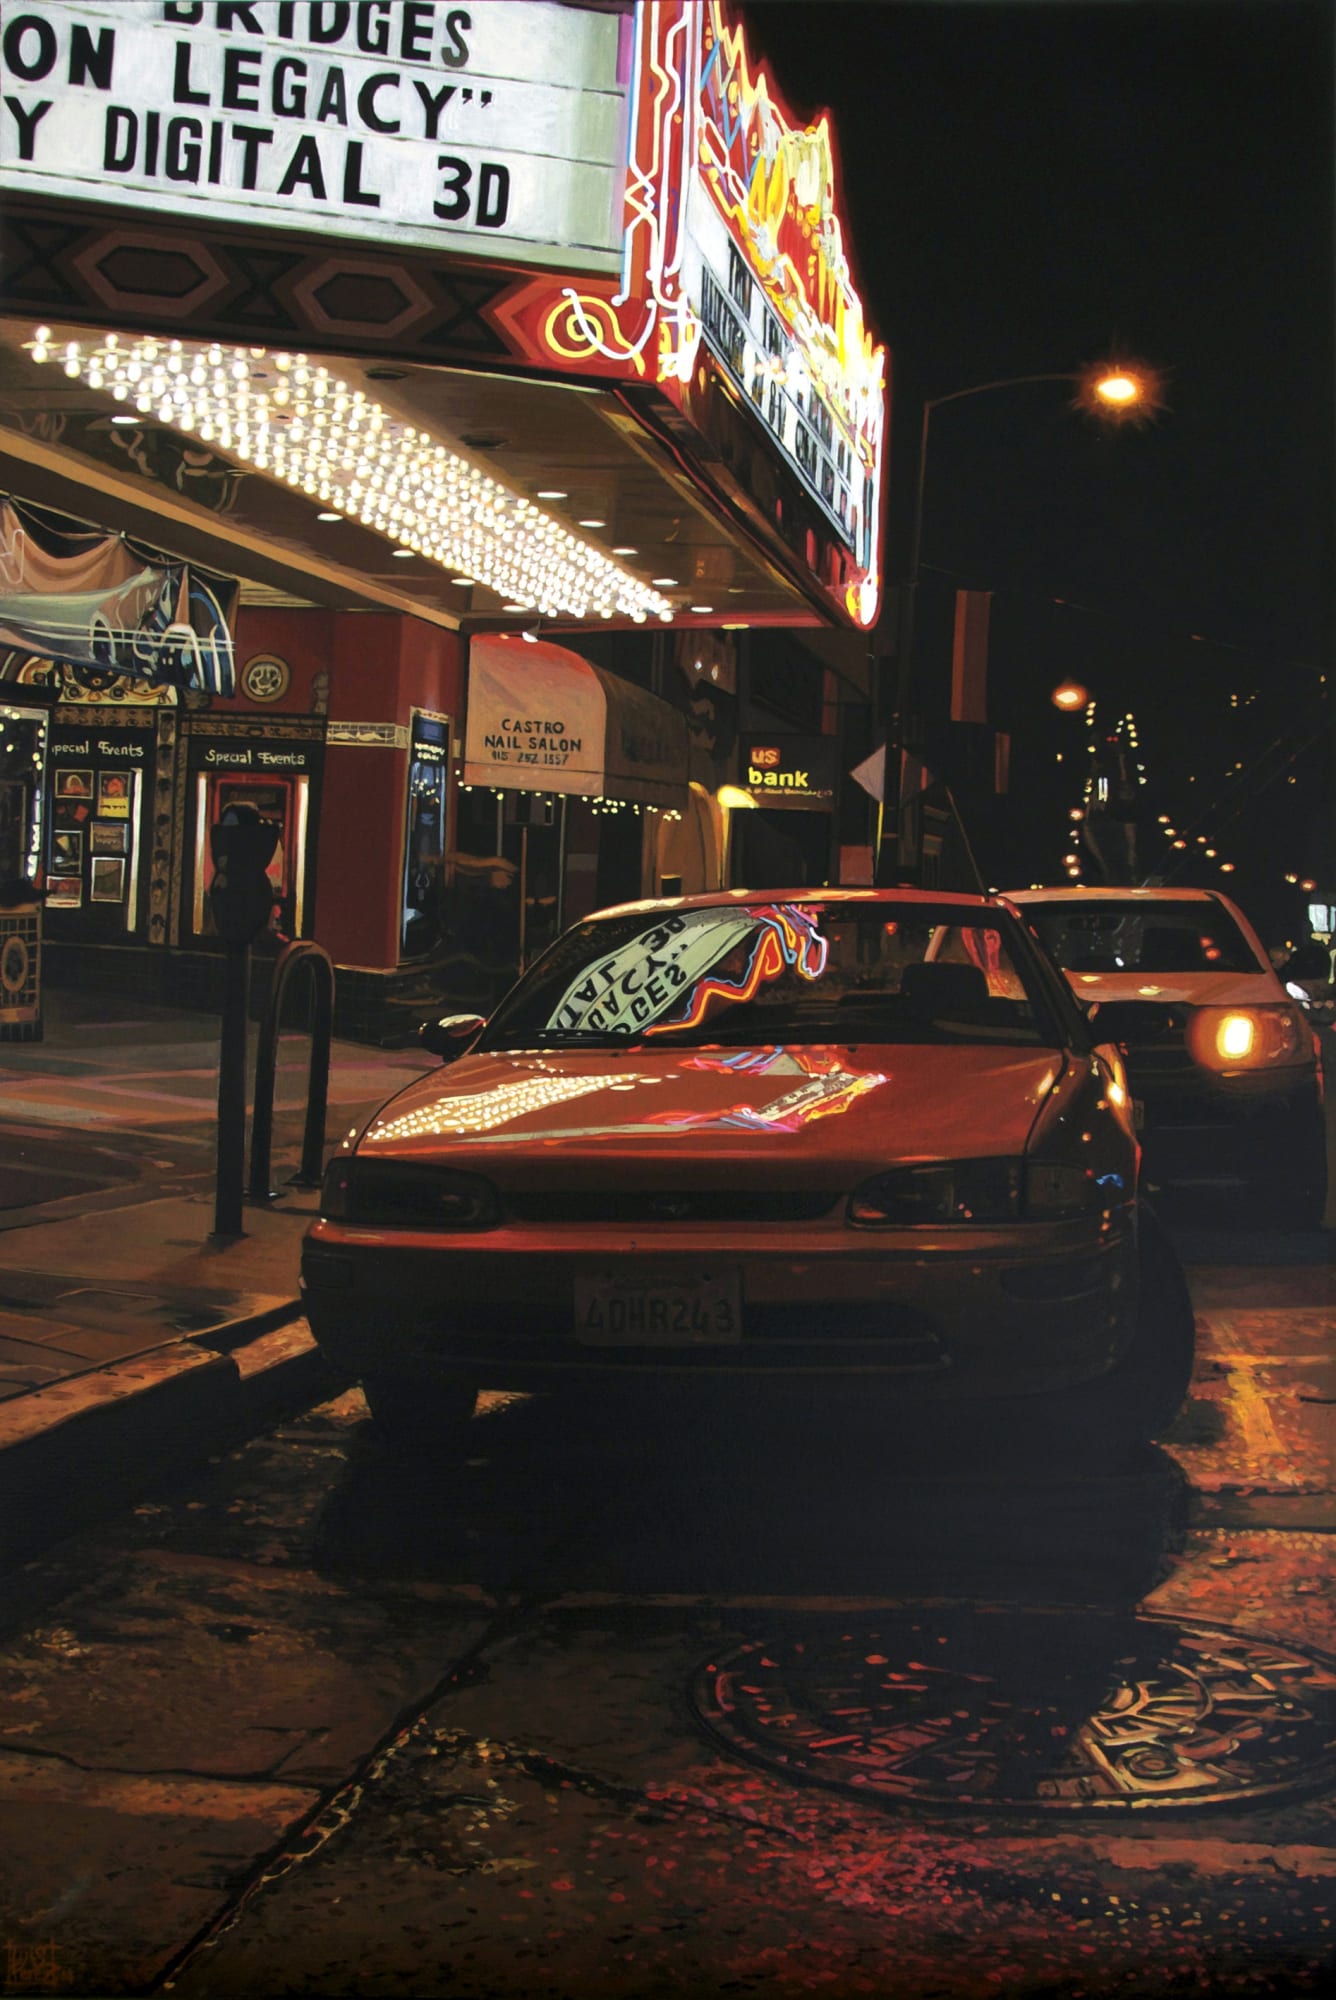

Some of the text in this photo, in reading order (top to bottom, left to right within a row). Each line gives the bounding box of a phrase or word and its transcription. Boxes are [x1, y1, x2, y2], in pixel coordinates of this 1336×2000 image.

[3, 14, 115, 91] ON
[103, 105, 382, 207] DIGITAL
[433, 156, 511, 229] 3D
[501, 718, 565, 734] CASTRO
[98, 741, 144, 757] Events
[484, 734, 582, 752] NAIL SALON
[205, 749, 305, 766] Special Events
[748, 766, 808, 788] bank
